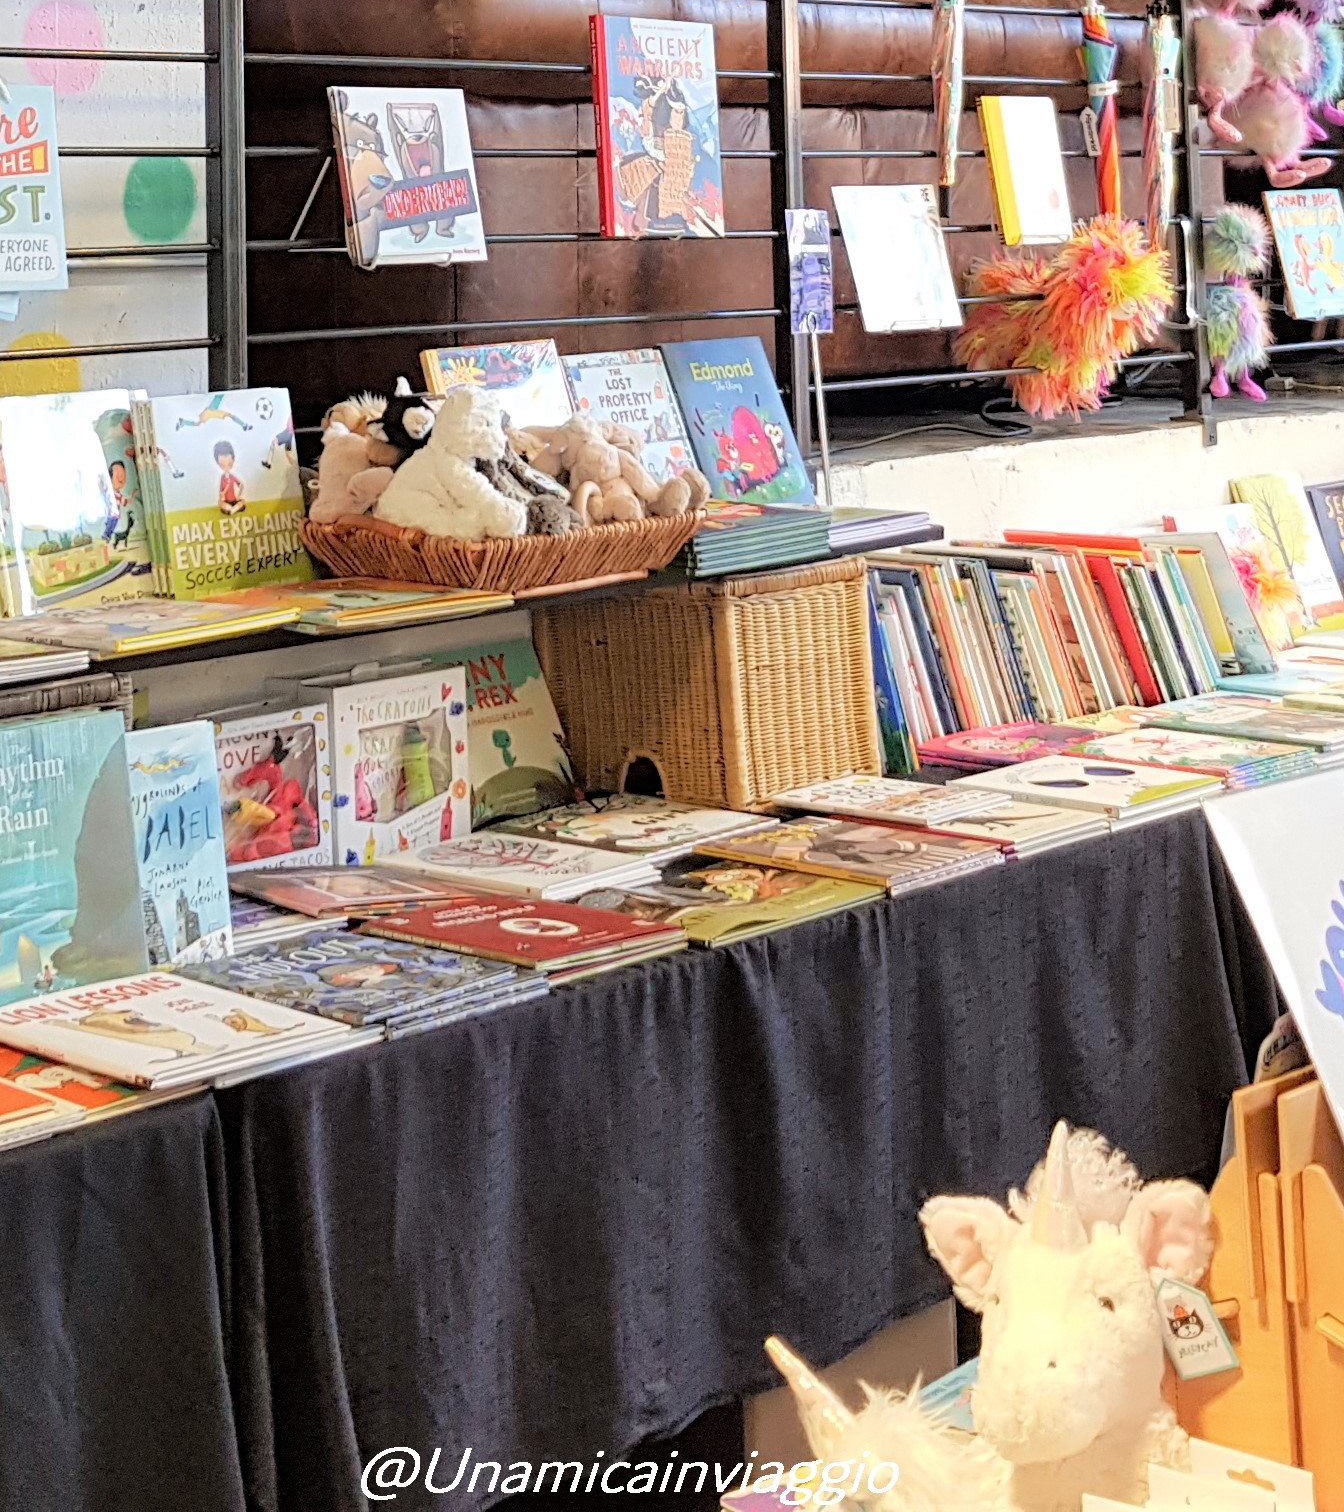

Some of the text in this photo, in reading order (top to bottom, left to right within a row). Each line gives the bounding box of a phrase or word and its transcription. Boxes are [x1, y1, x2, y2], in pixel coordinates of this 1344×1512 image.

[617, 38, 702, 59] ANCIENT
[618, 59, 704, 80] WARRIORS
[4, 255, 55, 273] AGREED.
[607, 367, 622, 377] THE
[689, 357, 756, 383] Edmond
[605, 376, 632, 390] LOST
[599, 392, 653, 408] PROPERTY
[610, 407, 649, 423] OFFICE
[172, 510, 304, 546] MAX EXPLAINS
[185, 548, 301, 590] SOCCER EXPERT
[476, 681, 520, 710] REX
[143, 804, 217, 864] BABEL
[54, 975, 182, 1014] LESSONS
